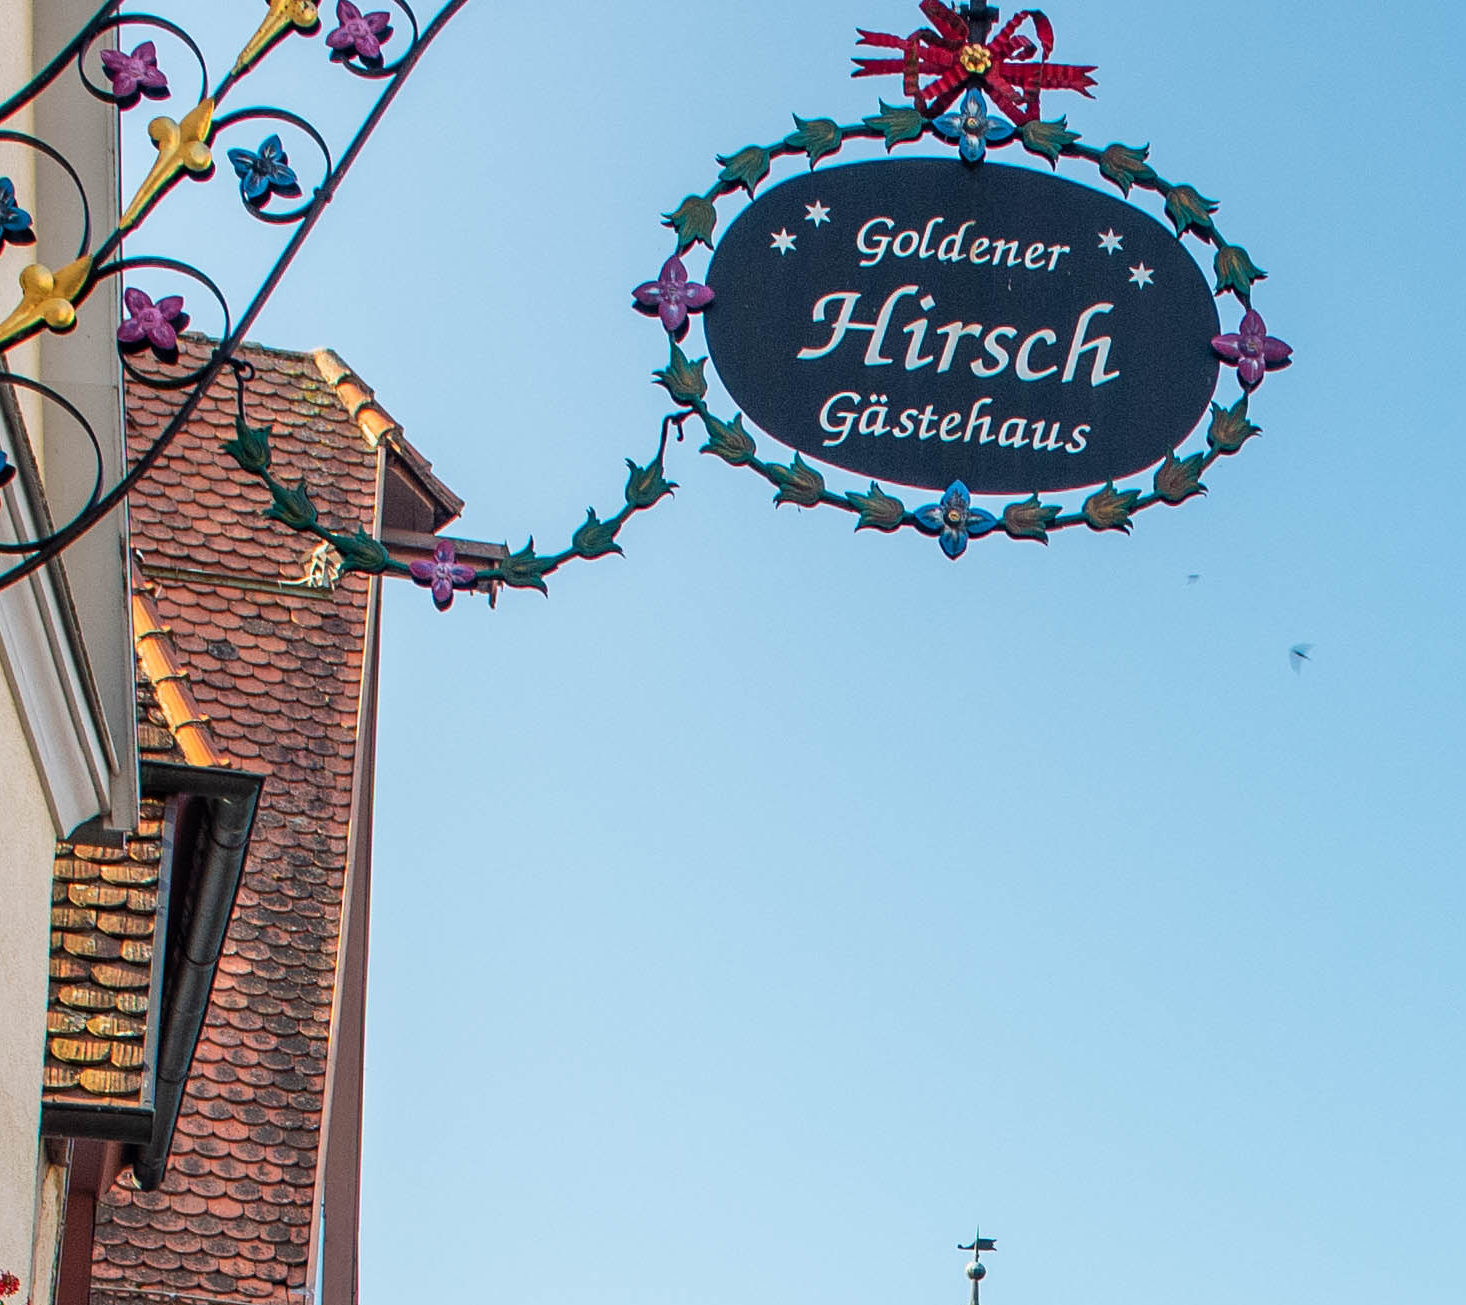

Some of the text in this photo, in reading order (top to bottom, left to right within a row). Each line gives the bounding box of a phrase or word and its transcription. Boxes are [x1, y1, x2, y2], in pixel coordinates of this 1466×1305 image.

[857, 217, 1070, 271] Goldener
[796, 285, 1120, 386] Hirsch
[818, 391, 1091, 455] Gästehaus
